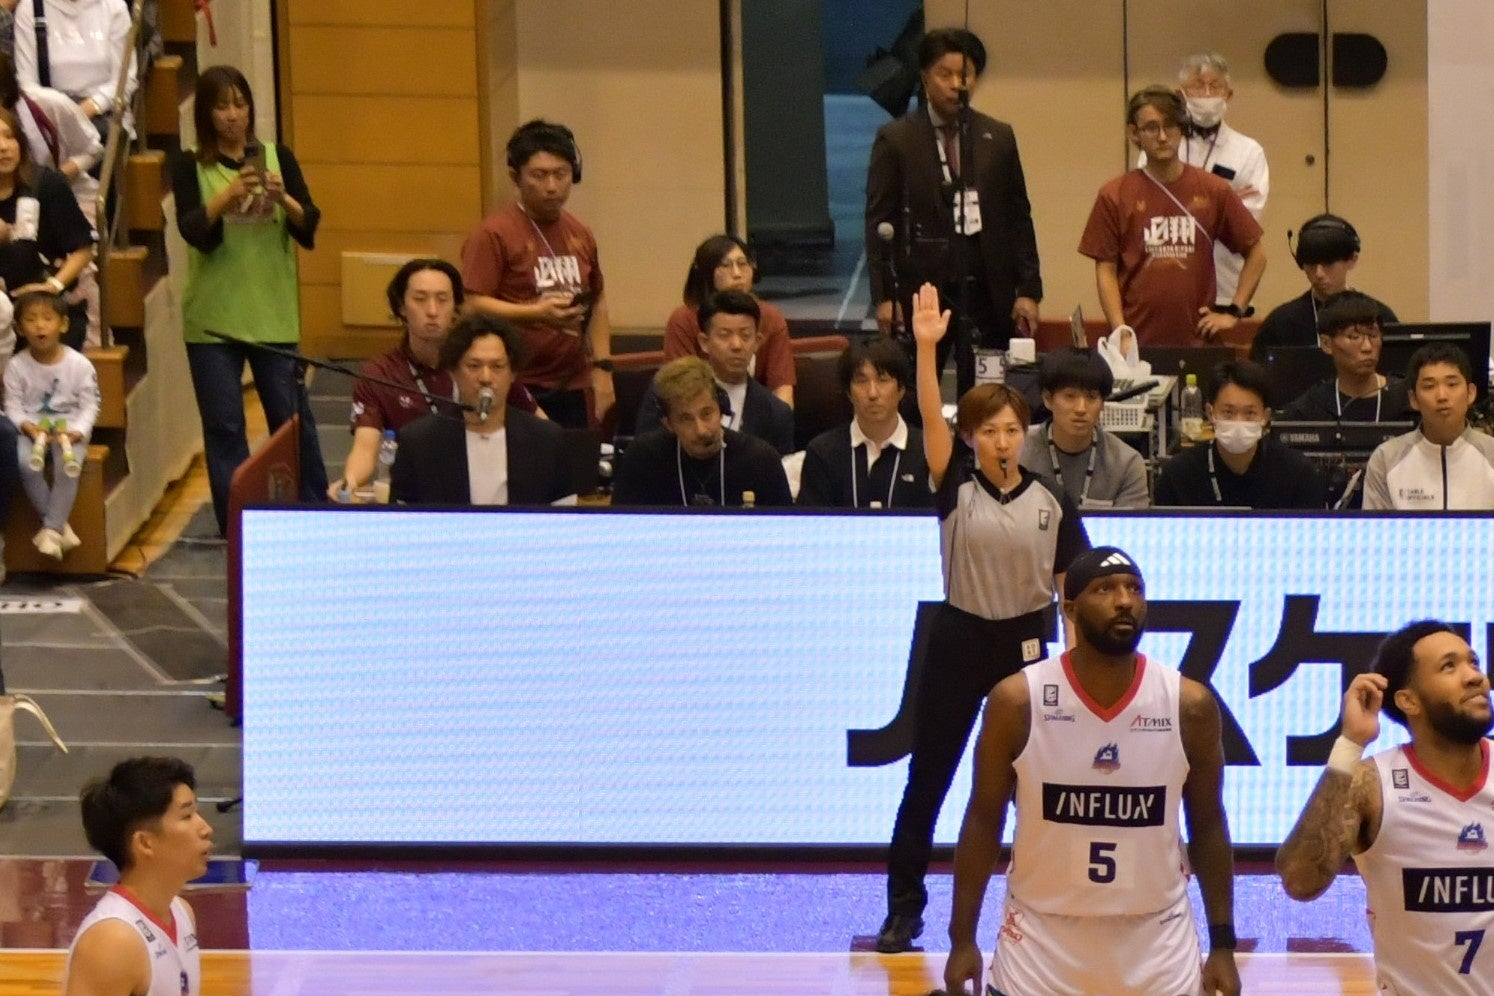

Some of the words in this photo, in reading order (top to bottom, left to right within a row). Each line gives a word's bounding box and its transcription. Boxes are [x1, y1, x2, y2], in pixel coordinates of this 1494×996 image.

[1056, 791, 1155, 820] INFLUX
[1087, 841, 1118, 884] 5
[1454, 929, 1486, 975] 7
